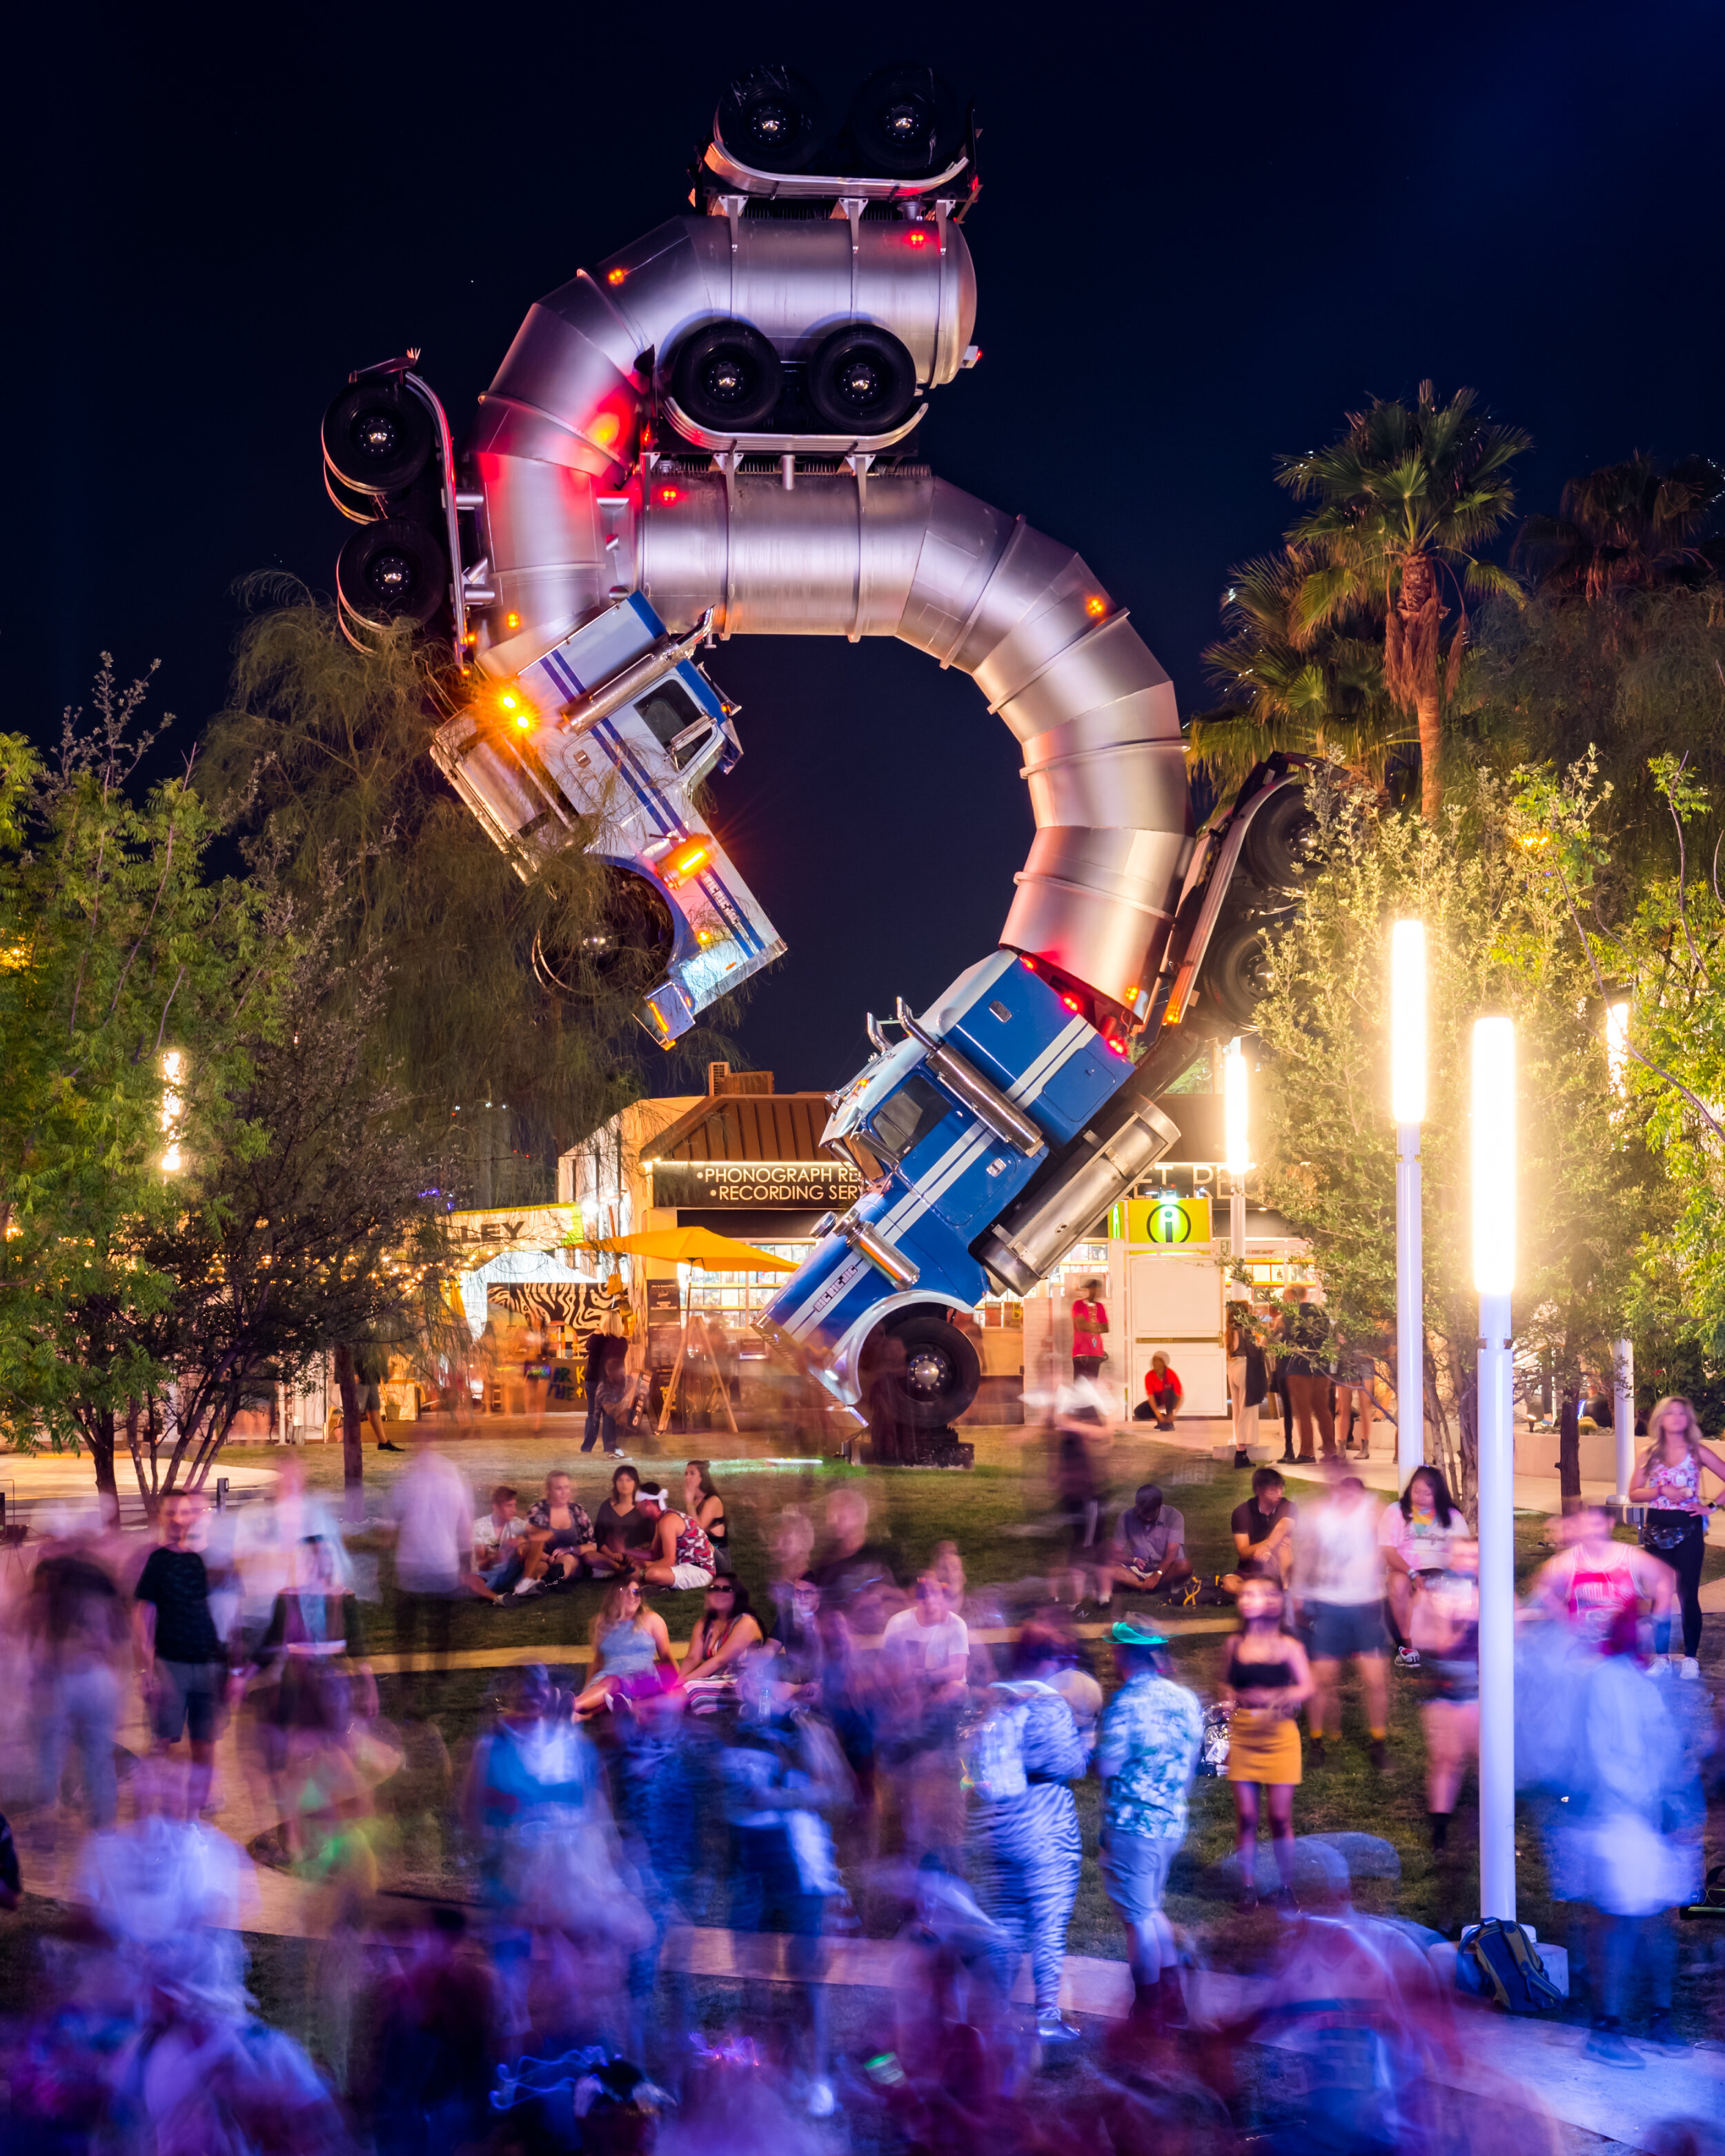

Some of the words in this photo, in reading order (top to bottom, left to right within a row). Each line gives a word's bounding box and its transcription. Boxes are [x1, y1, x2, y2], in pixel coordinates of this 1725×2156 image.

[705, 1167, 832, 1183] PHONOGRAPH
[1125, 1165, 1173, 1199] ET
[719, 1185, 824, 1200] RECORDING
